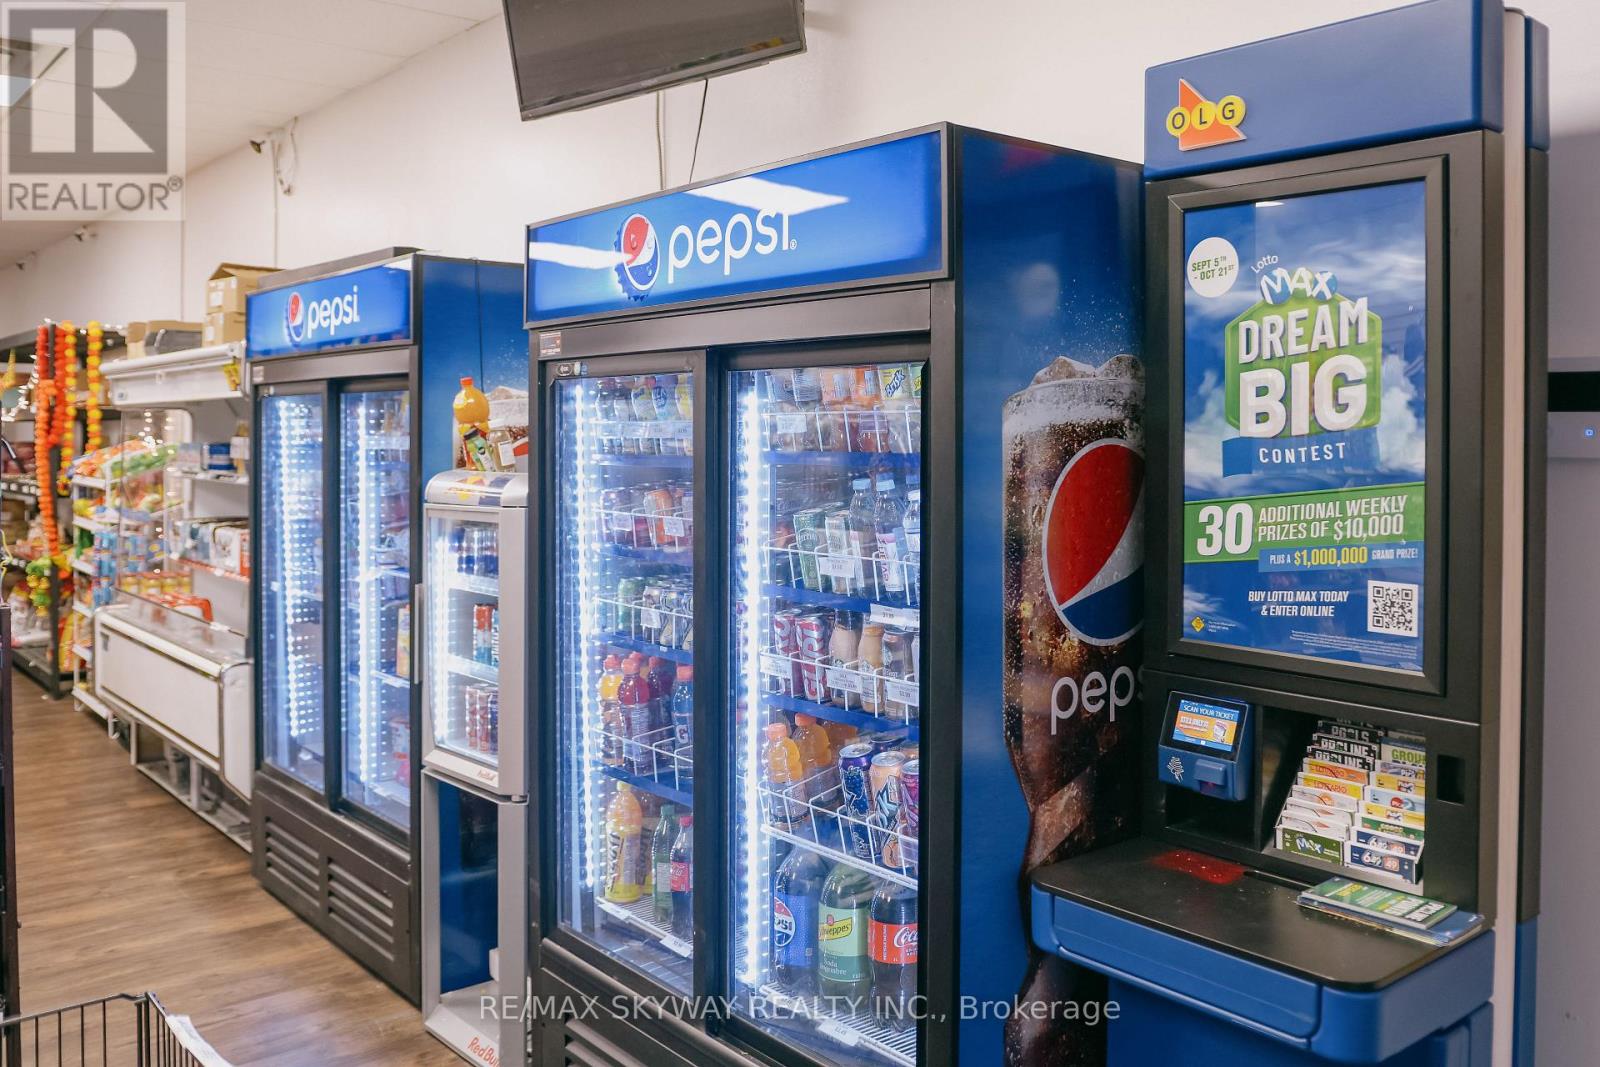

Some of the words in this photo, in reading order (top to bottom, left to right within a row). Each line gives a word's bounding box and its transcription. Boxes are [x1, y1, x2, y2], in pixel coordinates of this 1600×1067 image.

[1172, 102, 1234, 129] OLG
[1191, 259, 1212, 272] SEPT
[1200, 269, 1216, 281] OCT
[1251, 254, 1279, 274] Lotto
[1260, 267, 1333, 304] MAX
[307, 285, 360, 339] pepsi
[1239, 296, 1369, 364] DREAM
[1239, 355, 1368, 438] BIG
[1259, 443, 1346, 464] CONTEST
[1259, 501, 1343, 524] ADDITIONAL
[1346, 495, 1409, 516] WEEKLY
[1197, 503, 1253, 556] 30
[1258, 522, 1307, 542] PRIZES
[1311, 520, 1330, 538] OF
[1334, 514, 1404, 542] $10,000
[1270, 555, 1285, 565] PLUS
[1286, 555, 1291, 563] A
[1294, 547, 1368, 568] $1,000,000
[1372, 549, 1394, 560] GRAND
[1248, 591, 1266, 602] BUY
[1267, 591, 1294, 602] LOTTO
[1295, 591, 1317, 602] MAX
[1319, 591, 1349, 602] TODAY
[1261, 605, 1268, 616] &
[1270, 605, 1298, 616] ENTER
[1300, 605, 1335, 617] ONLINE
[1183, 704, 1198, 713] SCAN
[1200, 707, 1214, 716] YOUR
[1216, 710, 1234, 720] TICKET
